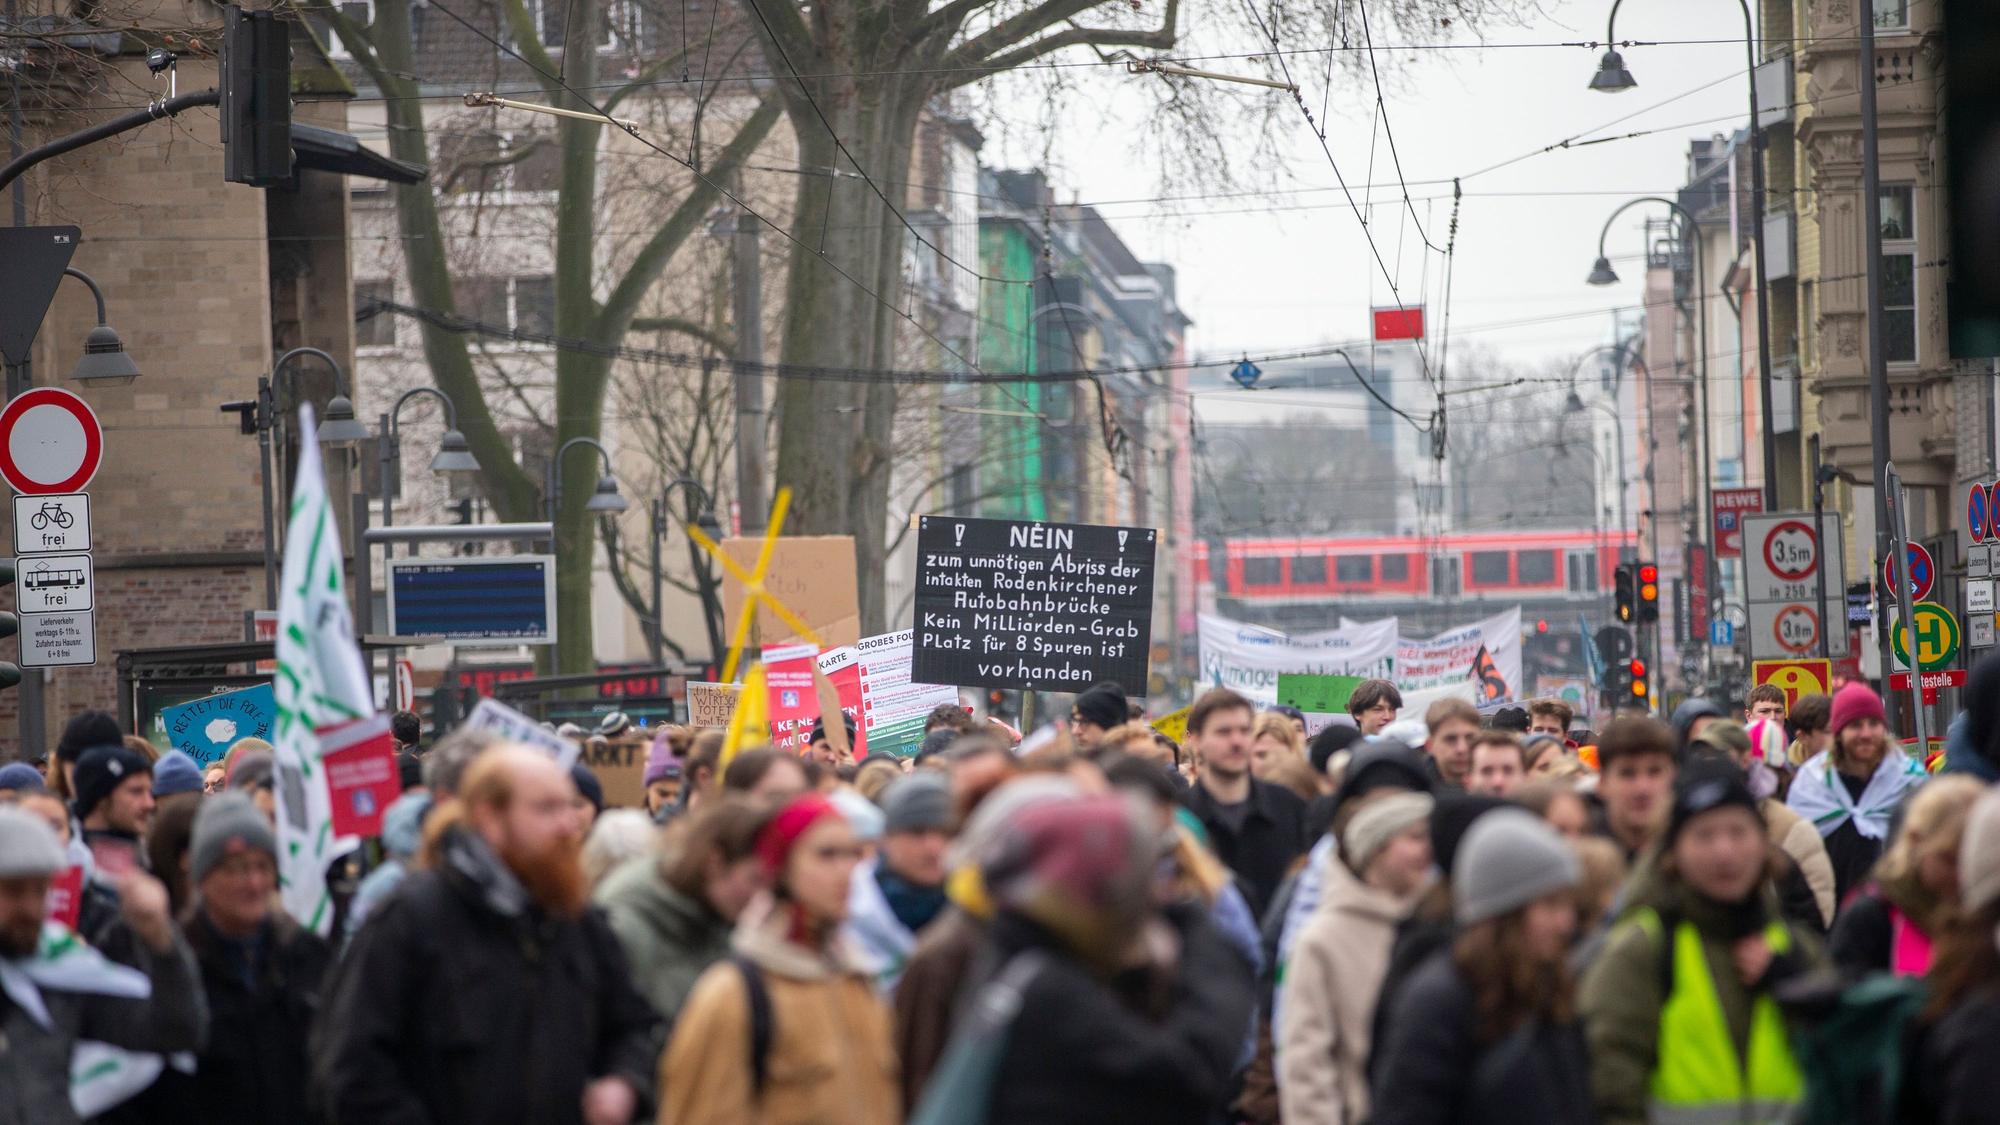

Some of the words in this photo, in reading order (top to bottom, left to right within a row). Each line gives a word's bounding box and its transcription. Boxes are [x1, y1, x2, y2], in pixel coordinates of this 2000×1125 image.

[1715, 492, 1760, 508] REWE
[42, 533, 65, 546] frei
[1010, 526, 1073, 550] NEIN
[926, 555, 962, 567] zum
[969, 554, 1044, 574] unnötigen
[1050, 553, 1106, 576] Abriss
[1110, 558, 1140, 578] der
[925, 571, 982, 589] intakten
[994, 573, 1137, 596] Rodenkirchener
[44, 592, 68, 605] frei
[1769, 586, 1781, 598] in
[1785, 586, 1806, 599] 250
[954, 591, 1110, 615] Autobahnbrücke
[40, 617, 74, 626] Lieferverkehr
[924, 612, 961, 629] Kein
[35, 629, 58, 638] werktags
[858, 636, 894, 651] GROBES
[896, 631, 914, 643] FOU
[1914, 619, 1942, 656] H
[36, 640, 55, 648] Zufahrt
[983, 635, 1006, 654] für
[1016, 635, 1027, 651] 8
[1033, 636, 1092, 657] Spuren
[1101, 641, 1125, 657] ist
[61, 649, 71, 657] frei
[818, 652, 847, 670] KARTE
[978, 659, 1092, 682] vorhanden
[1907, 672, 1952, 689] Htestelle
[173, 700, 213, 735] RETTET
[219, 698, 237, 711] DIE
[240, 699, 265, 721] POLE
[778, 717, 814, 732] KENE
[180, 740, 213, 762] RAUS
[902, 743, 918, 753] VCD
